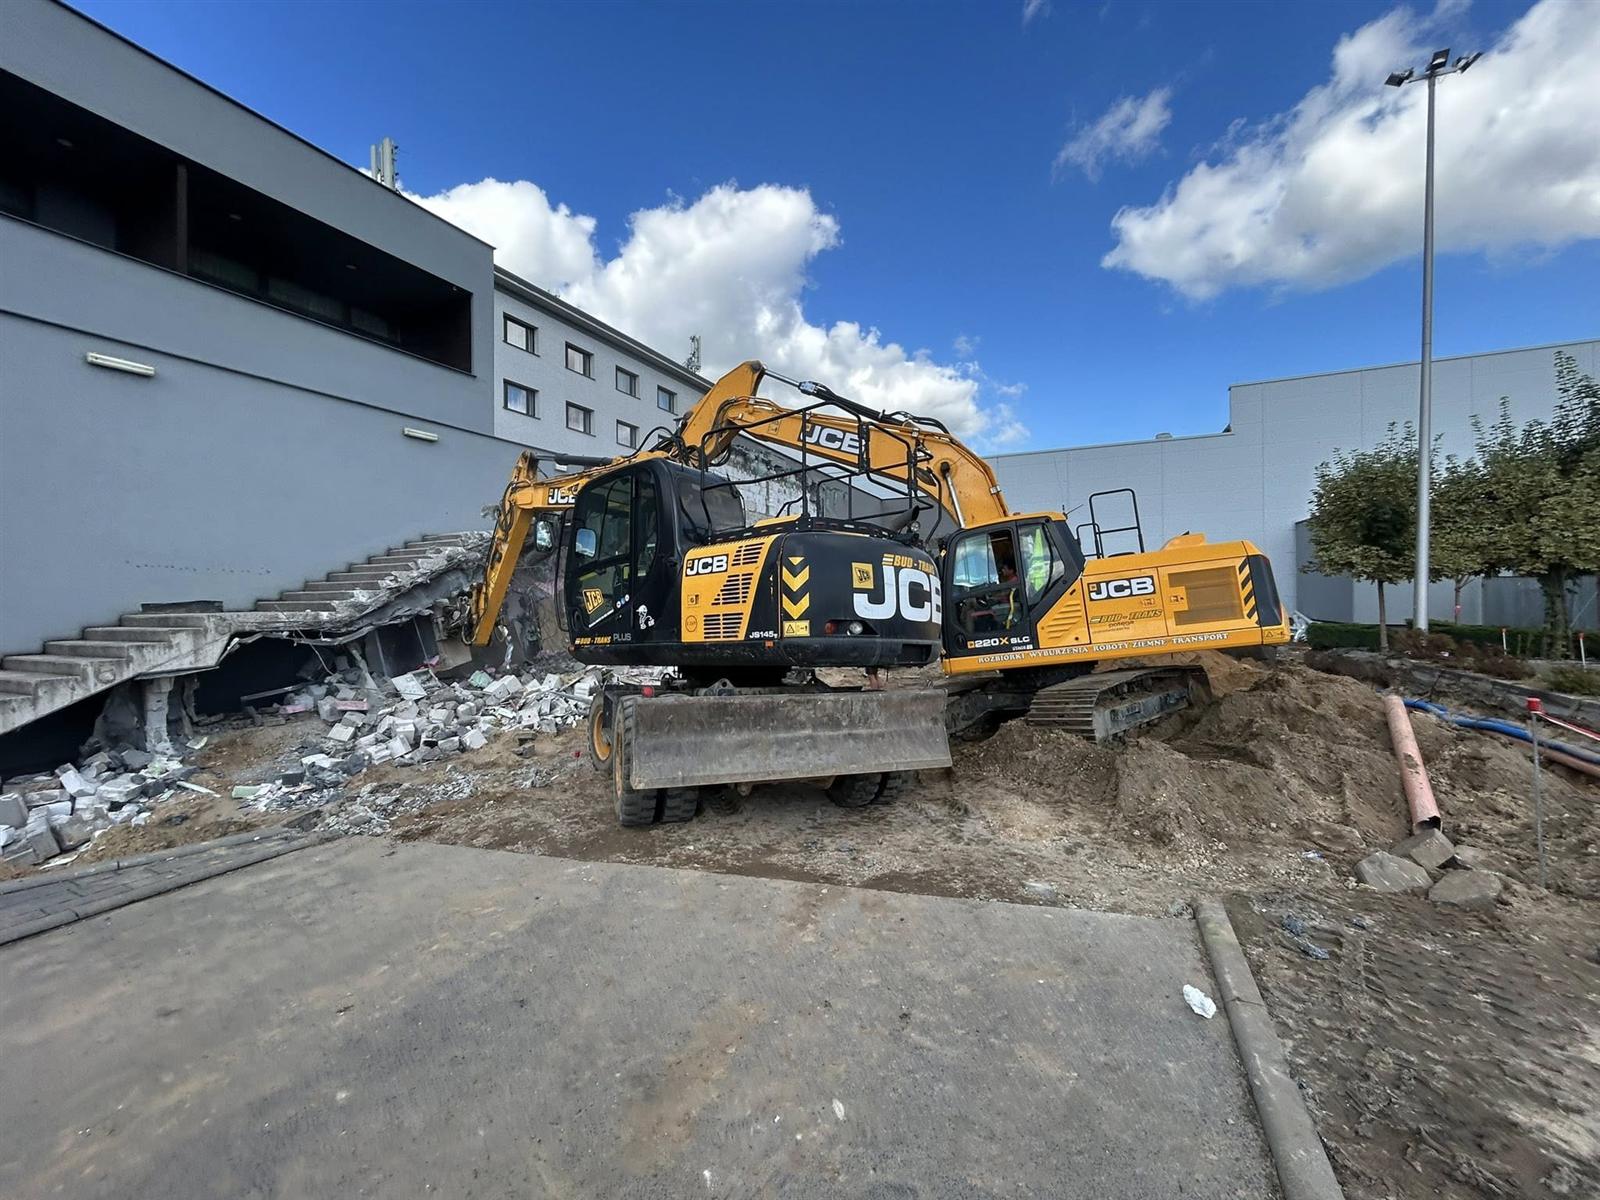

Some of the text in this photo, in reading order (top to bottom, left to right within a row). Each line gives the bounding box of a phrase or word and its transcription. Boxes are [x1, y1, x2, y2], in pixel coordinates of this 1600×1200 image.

[686, 555, 728, 576] JCB
[894, 555, 913, 568] BUD
[1090, 577, 1154, 600] JCB
[586, 590, 602, 611] JCB
[613, 633, 632, 642] PLUS
[1029, 646, 1088, 658] WYBURZENIA
[1093, 642, 1129, 652] ROBOTY
[1172, 632, 1229, 645] TRANSPORT
